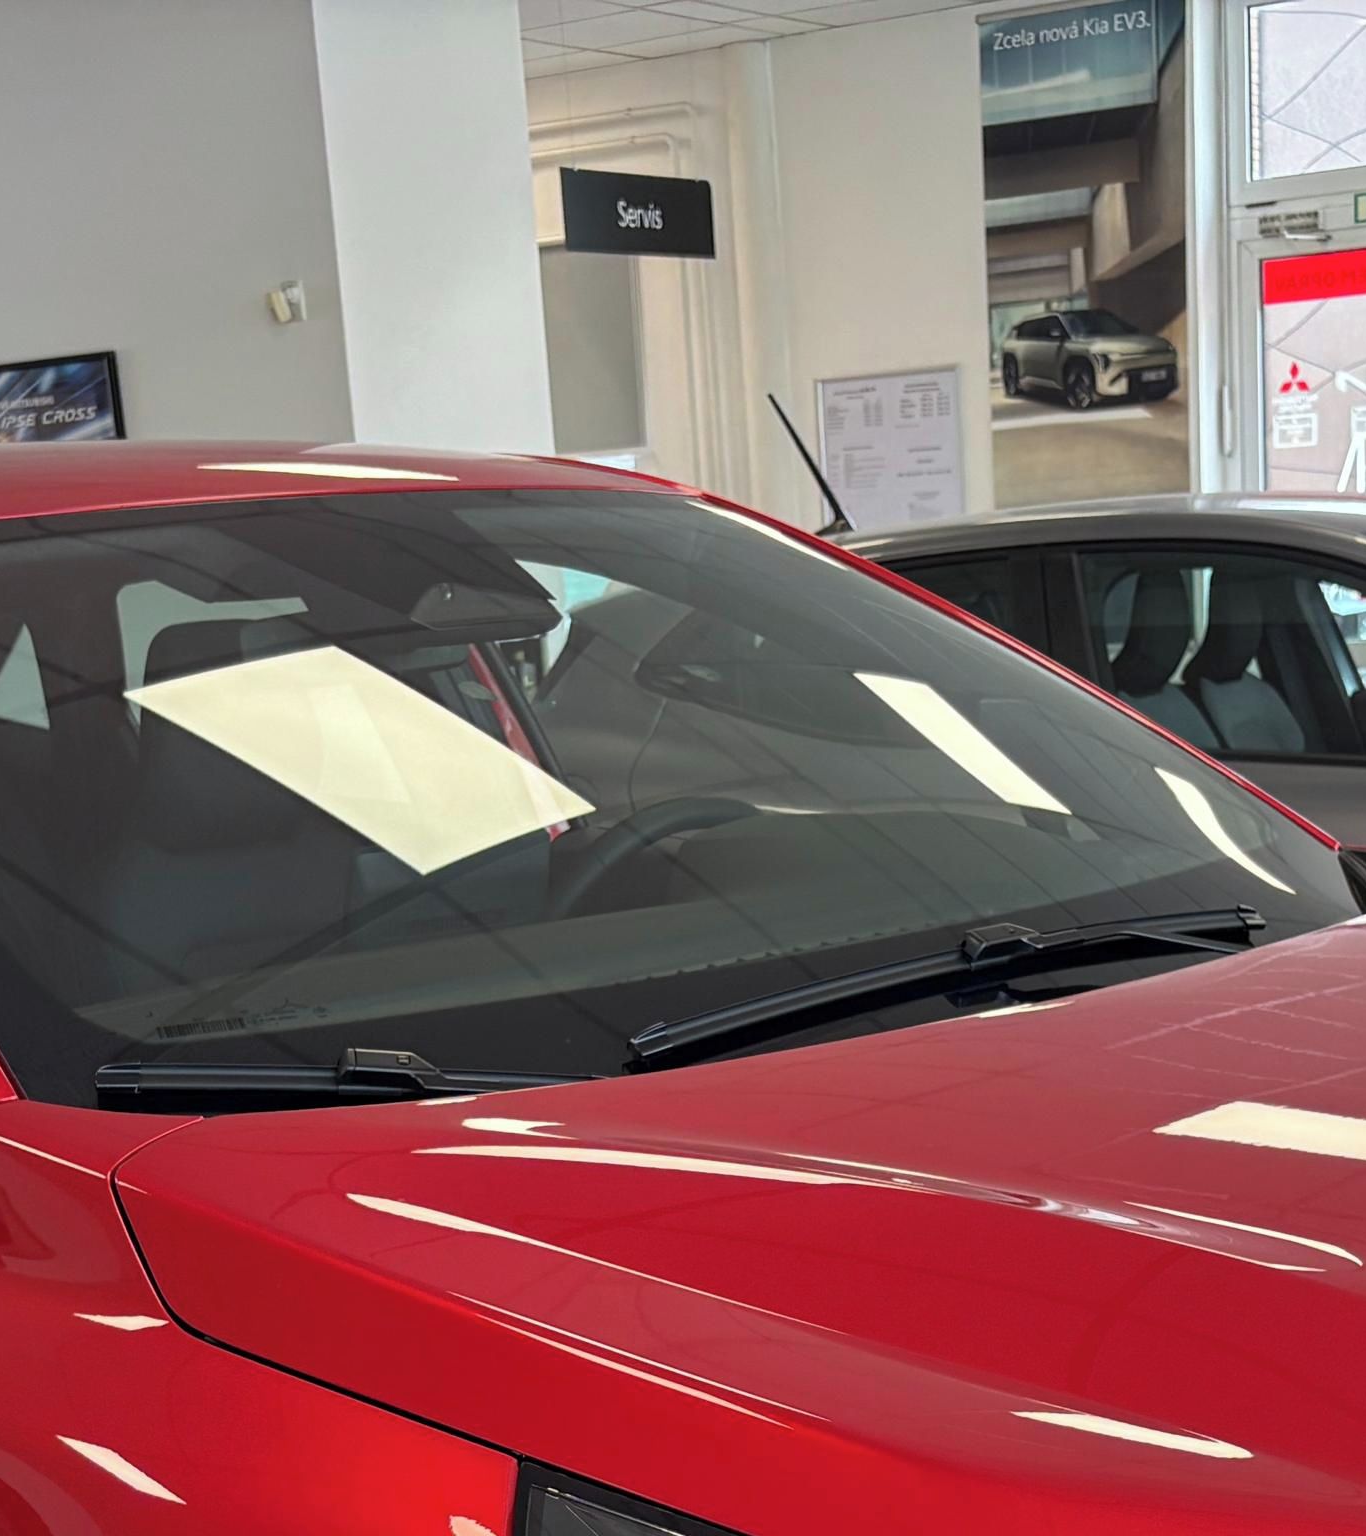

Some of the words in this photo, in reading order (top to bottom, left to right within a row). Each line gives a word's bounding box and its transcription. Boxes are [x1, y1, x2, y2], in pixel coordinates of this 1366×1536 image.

[993, 30, 1035, 51] Zcela
[1039, 21, 1079, 44] nová
[1083, 18, 1109, 36] Kia
[1114, 10, 1151, 32] EV3.
[617, 198, 664, 230] Servis
[42, 406, 98, 425] CROSS
